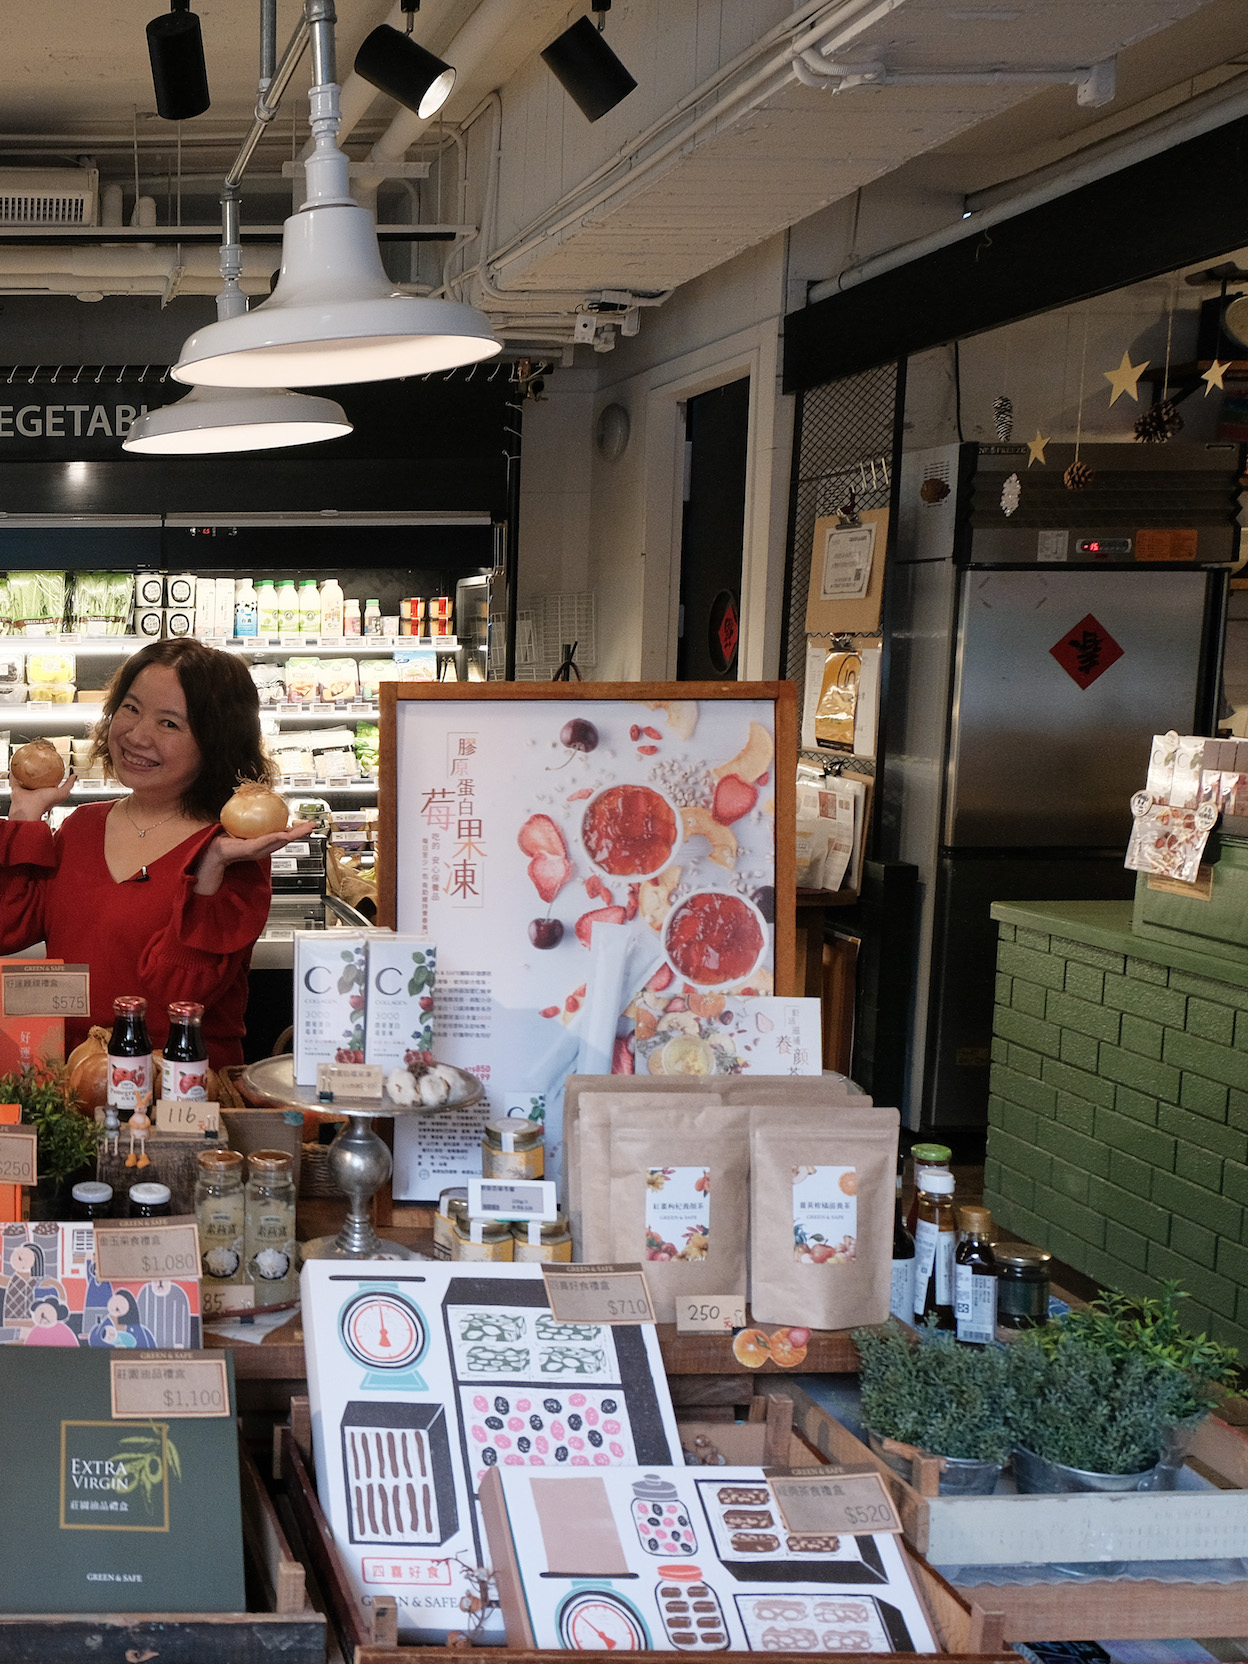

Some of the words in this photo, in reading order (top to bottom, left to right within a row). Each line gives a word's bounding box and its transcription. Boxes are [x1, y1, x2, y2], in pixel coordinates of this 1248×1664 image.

[52, 996, 84, 1009] $575
[169, 1107, 196, 1123] 116
[141, 1253, 195, 1273] $1,080
[607, 1299, 647, 1315] $710
[687, 1304, 720, 1321] 250
[163, 1389, 221, 1407] $1,100
[71, 1457, 127, 1476] EXTRA
[72, 1475, 129, 1490] VIRGIN
[844, 1504, 891, 1525] $520
[86, 1572, 113, 1582] GREEN
[115, 1573, 122, 1582] &
[123, 1573, 143, 1583] SAFE
[412, 1597, 422, 1608] &
[425, 1597, 460, 1609] SAFE
